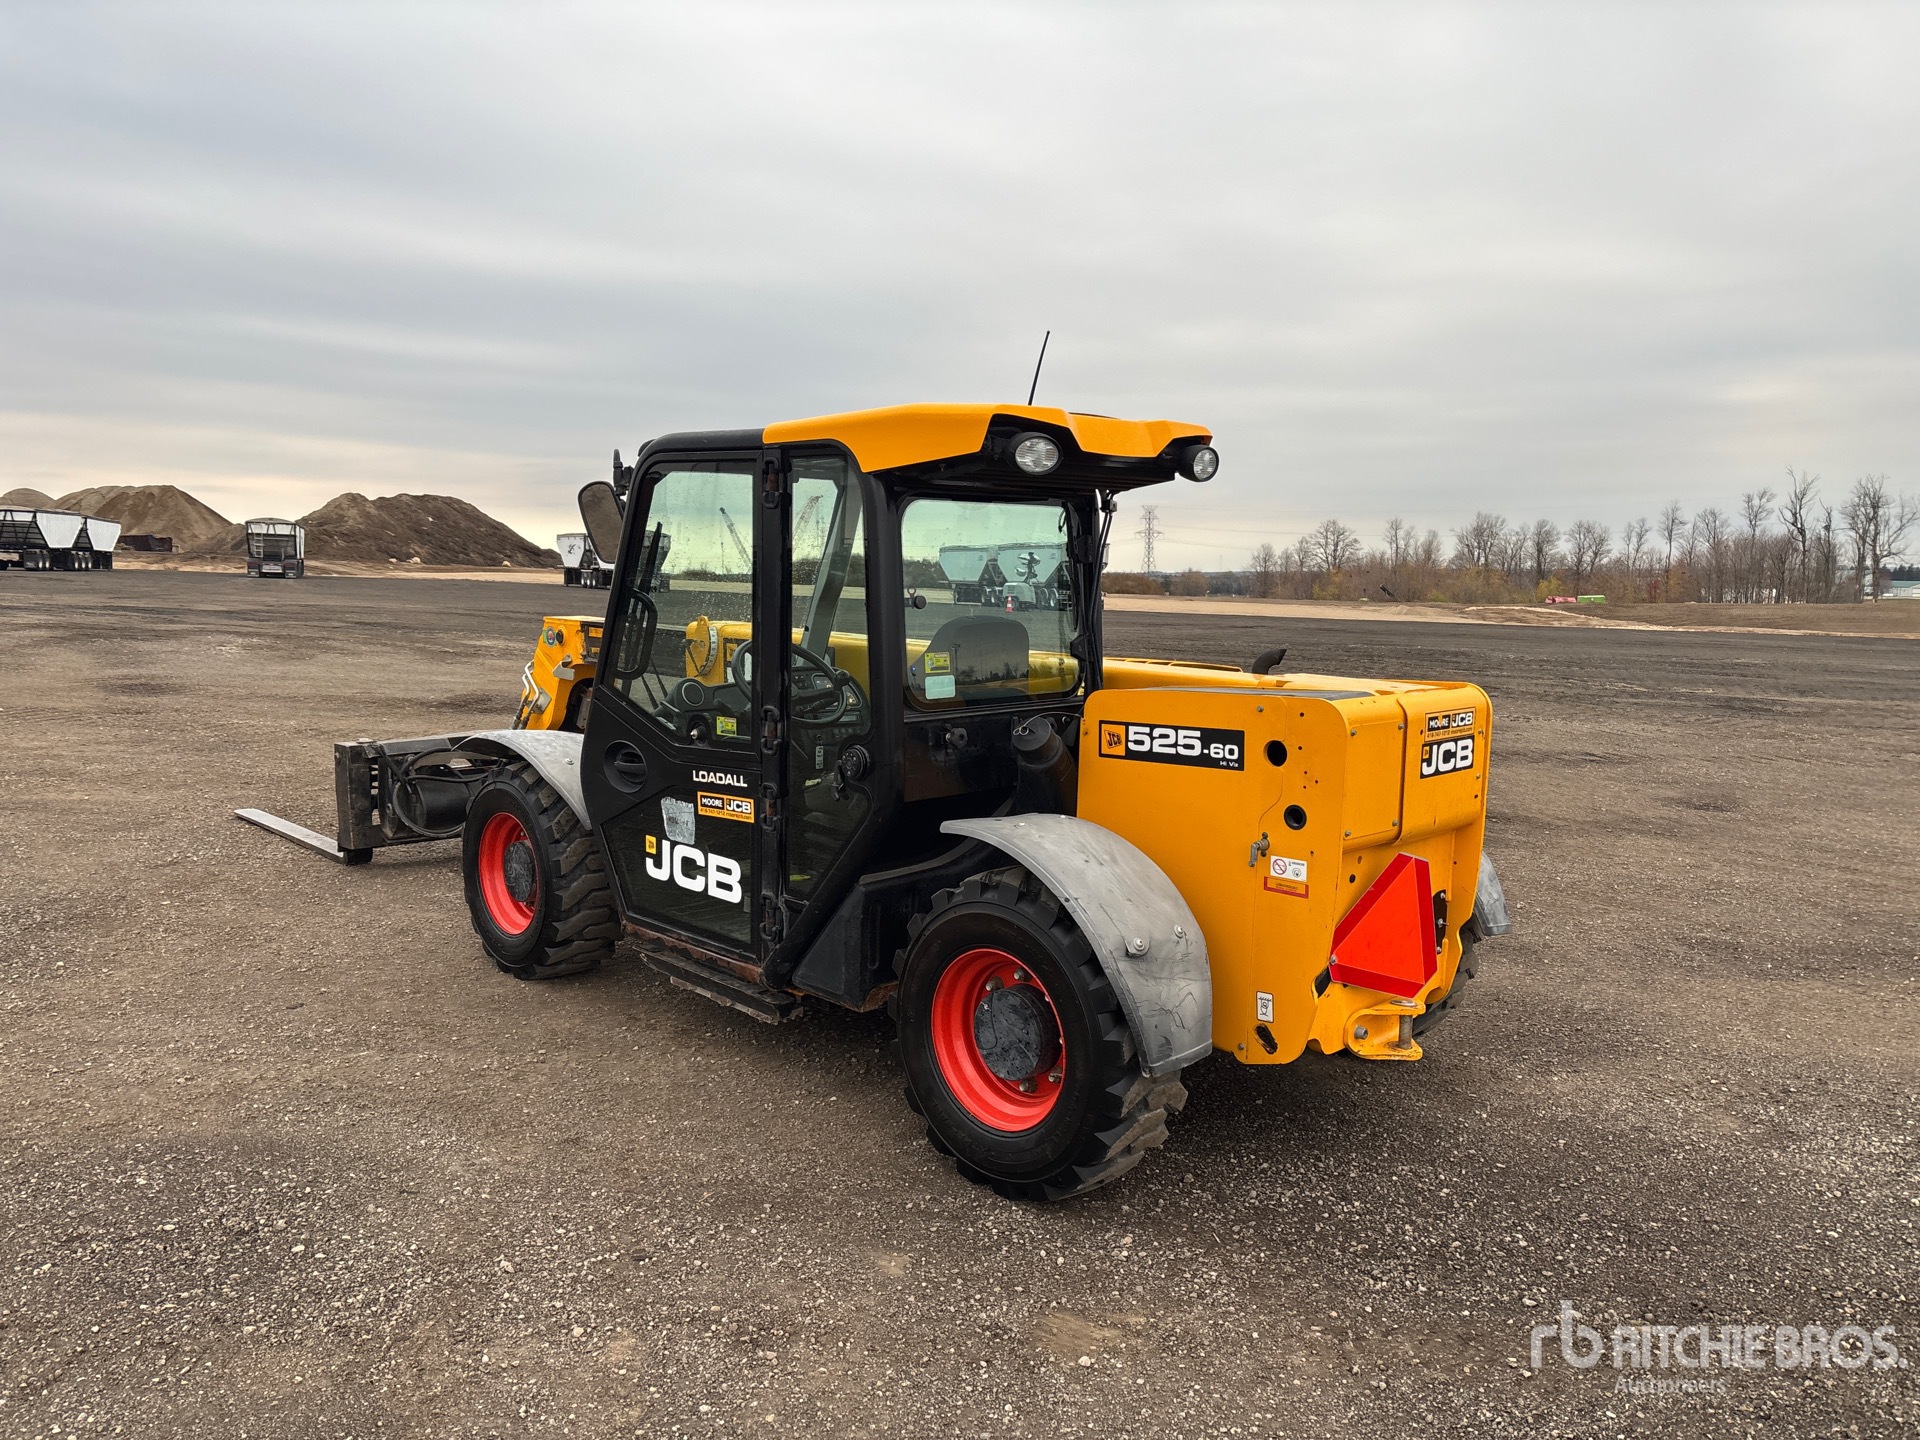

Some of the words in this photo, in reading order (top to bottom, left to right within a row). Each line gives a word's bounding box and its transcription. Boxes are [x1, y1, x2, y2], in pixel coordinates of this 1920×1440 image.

[1452, 712, 1473, 727] JCB
[1422, 739, 1473, 775] JCB
[693, 770, 748, 787] LOADALL
[701, 797, 723, 807] MOORE
[726, 799, 751, 814] JCB
[645, 839, 742, 904] JCB
